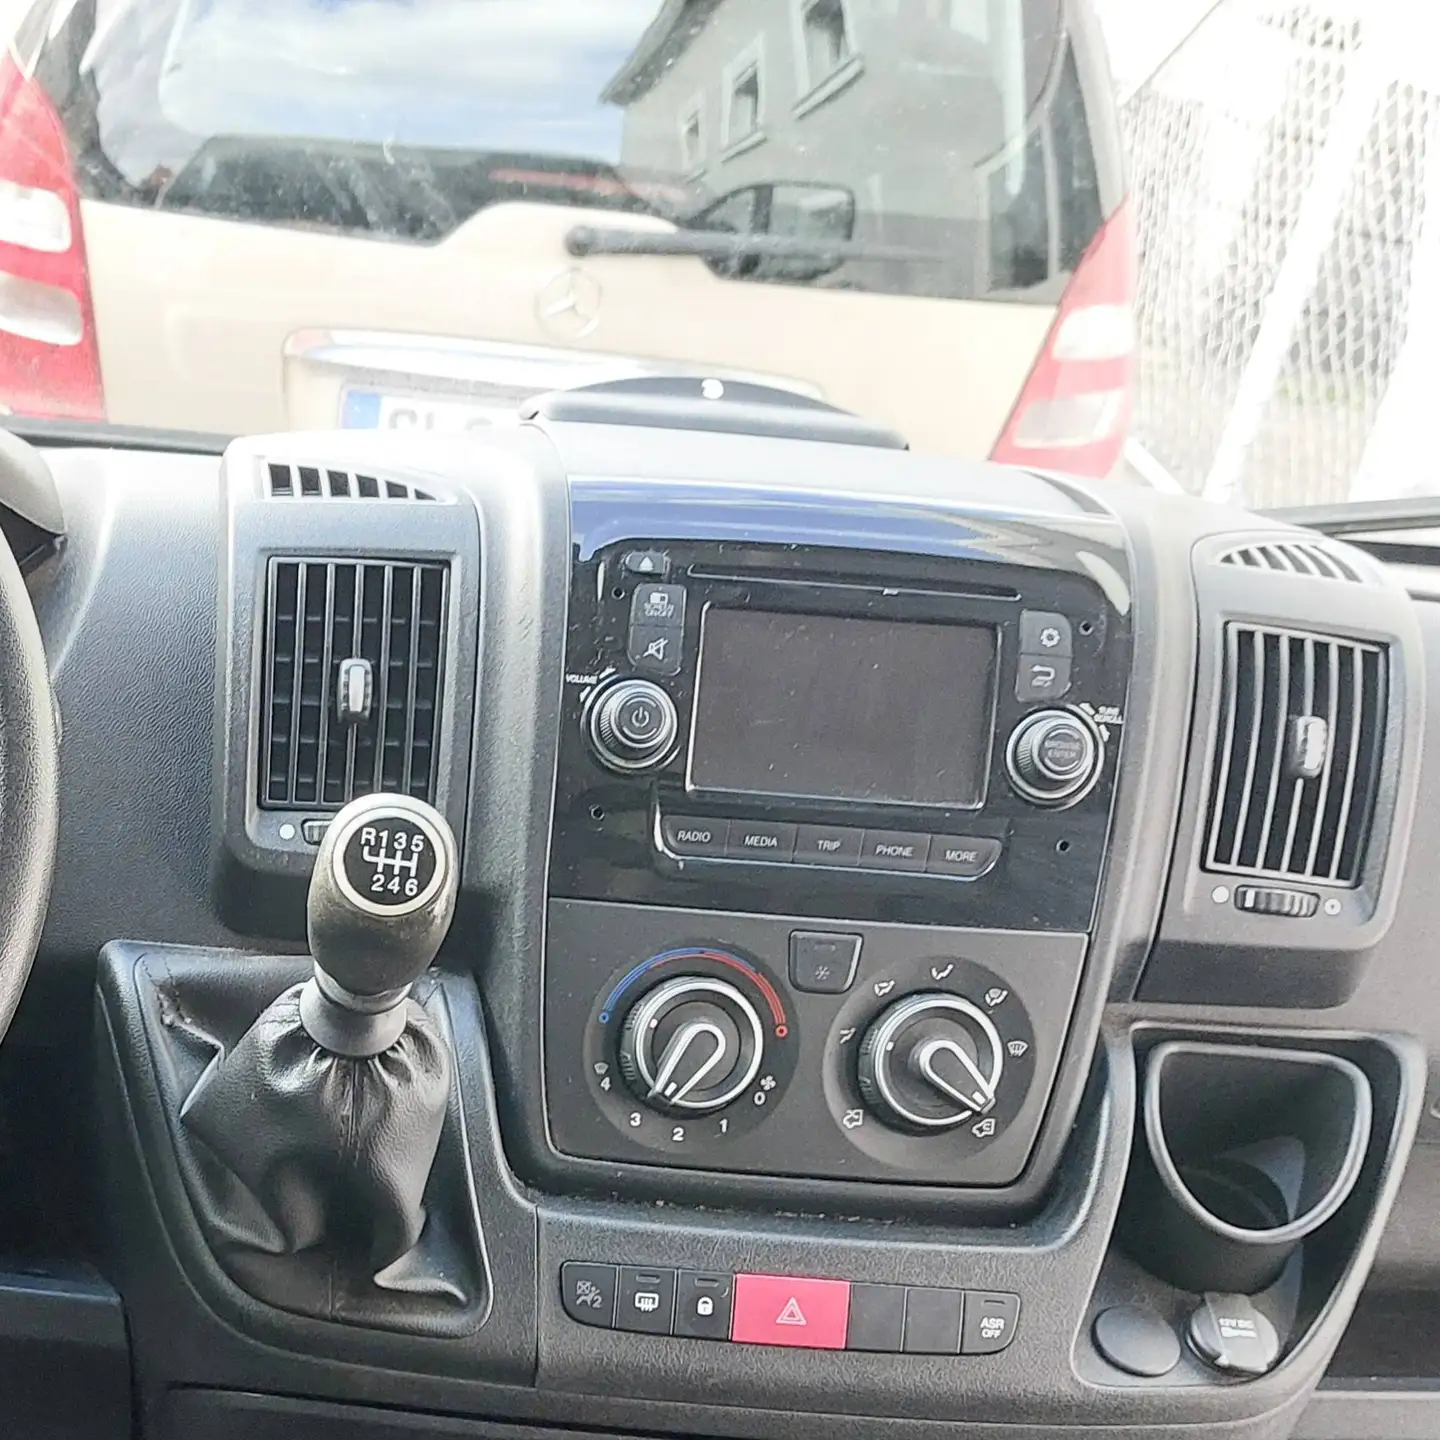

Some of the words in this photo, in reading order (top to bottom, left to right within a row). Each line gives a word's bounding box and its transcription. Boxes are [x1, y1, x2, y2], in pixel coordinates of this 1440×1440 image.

[360, 827, 377, 846] R
[378, 830, 389, 847] 1
[393, 832, 407, 849] 3
[410, 835, 425, 852] 5
[677, 830, 711, 843] RADIO
[744, 835, 778, 847] MEDIA
[817, 839, 841, 851] TRIP
[875, 844, 913, 857] PHONE
[945, 850, 978, 862] MORE
[371, 874, 386, 892] 2
[387, 876, 401, 894] 4
[405, 878, 419, 896] 6
[600, 1076, 611, 1092] 4
[753, 1091, 766, 1105] 0
[630, 1112, 642, 1127] 3
[719, 1118, 728, 1133] 1
[672, 1127, 685, 1141] 2
[980, 1316, 1005, 1330] ASR
[981, 1328, 1001, 1339] OFF
